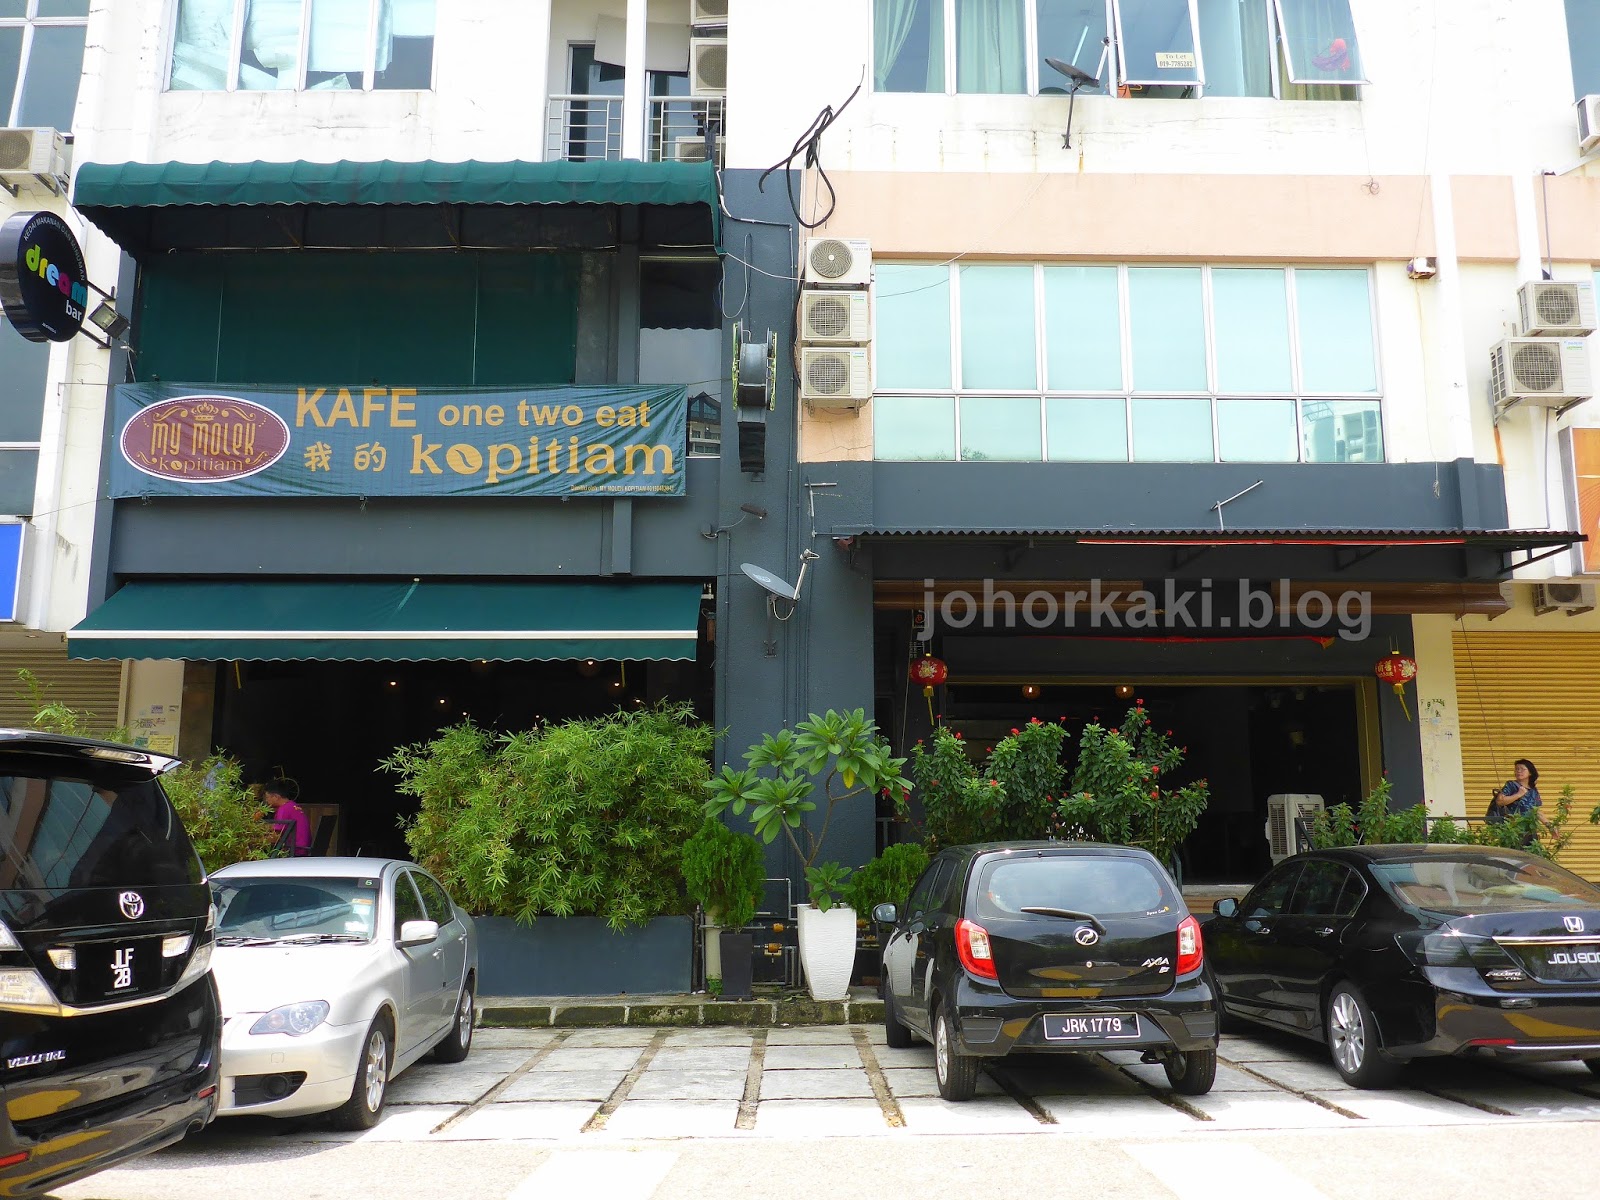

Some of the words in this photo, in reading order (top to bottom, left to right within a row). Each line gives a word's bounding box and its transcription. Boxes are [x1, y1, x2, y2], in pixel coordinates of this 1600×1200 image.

[23, 221, 37, 241] KEDAI
[36, 216, 61, 229] MAKANAN
[60, 225, 71, 241] DAN
[25, 244, 87, 308] dream
[65, 299, 82, 321] bar
[295, 387, 417, 428] KAFE
[438, 404, 505, 426] one
[517, 399, 584, 426] two
[595, 400, 651, 427] eat
[158, 456, 243, 473] kopitiam
[409, 433, 675, 484] kopitiam
[110, 947, 135, 969] JLF
[1141, 956, 1170, 968] AXIA
[1061, 1018, 1089, 1033] JRK
[1090, 1017, 1122, 1033] 1779
